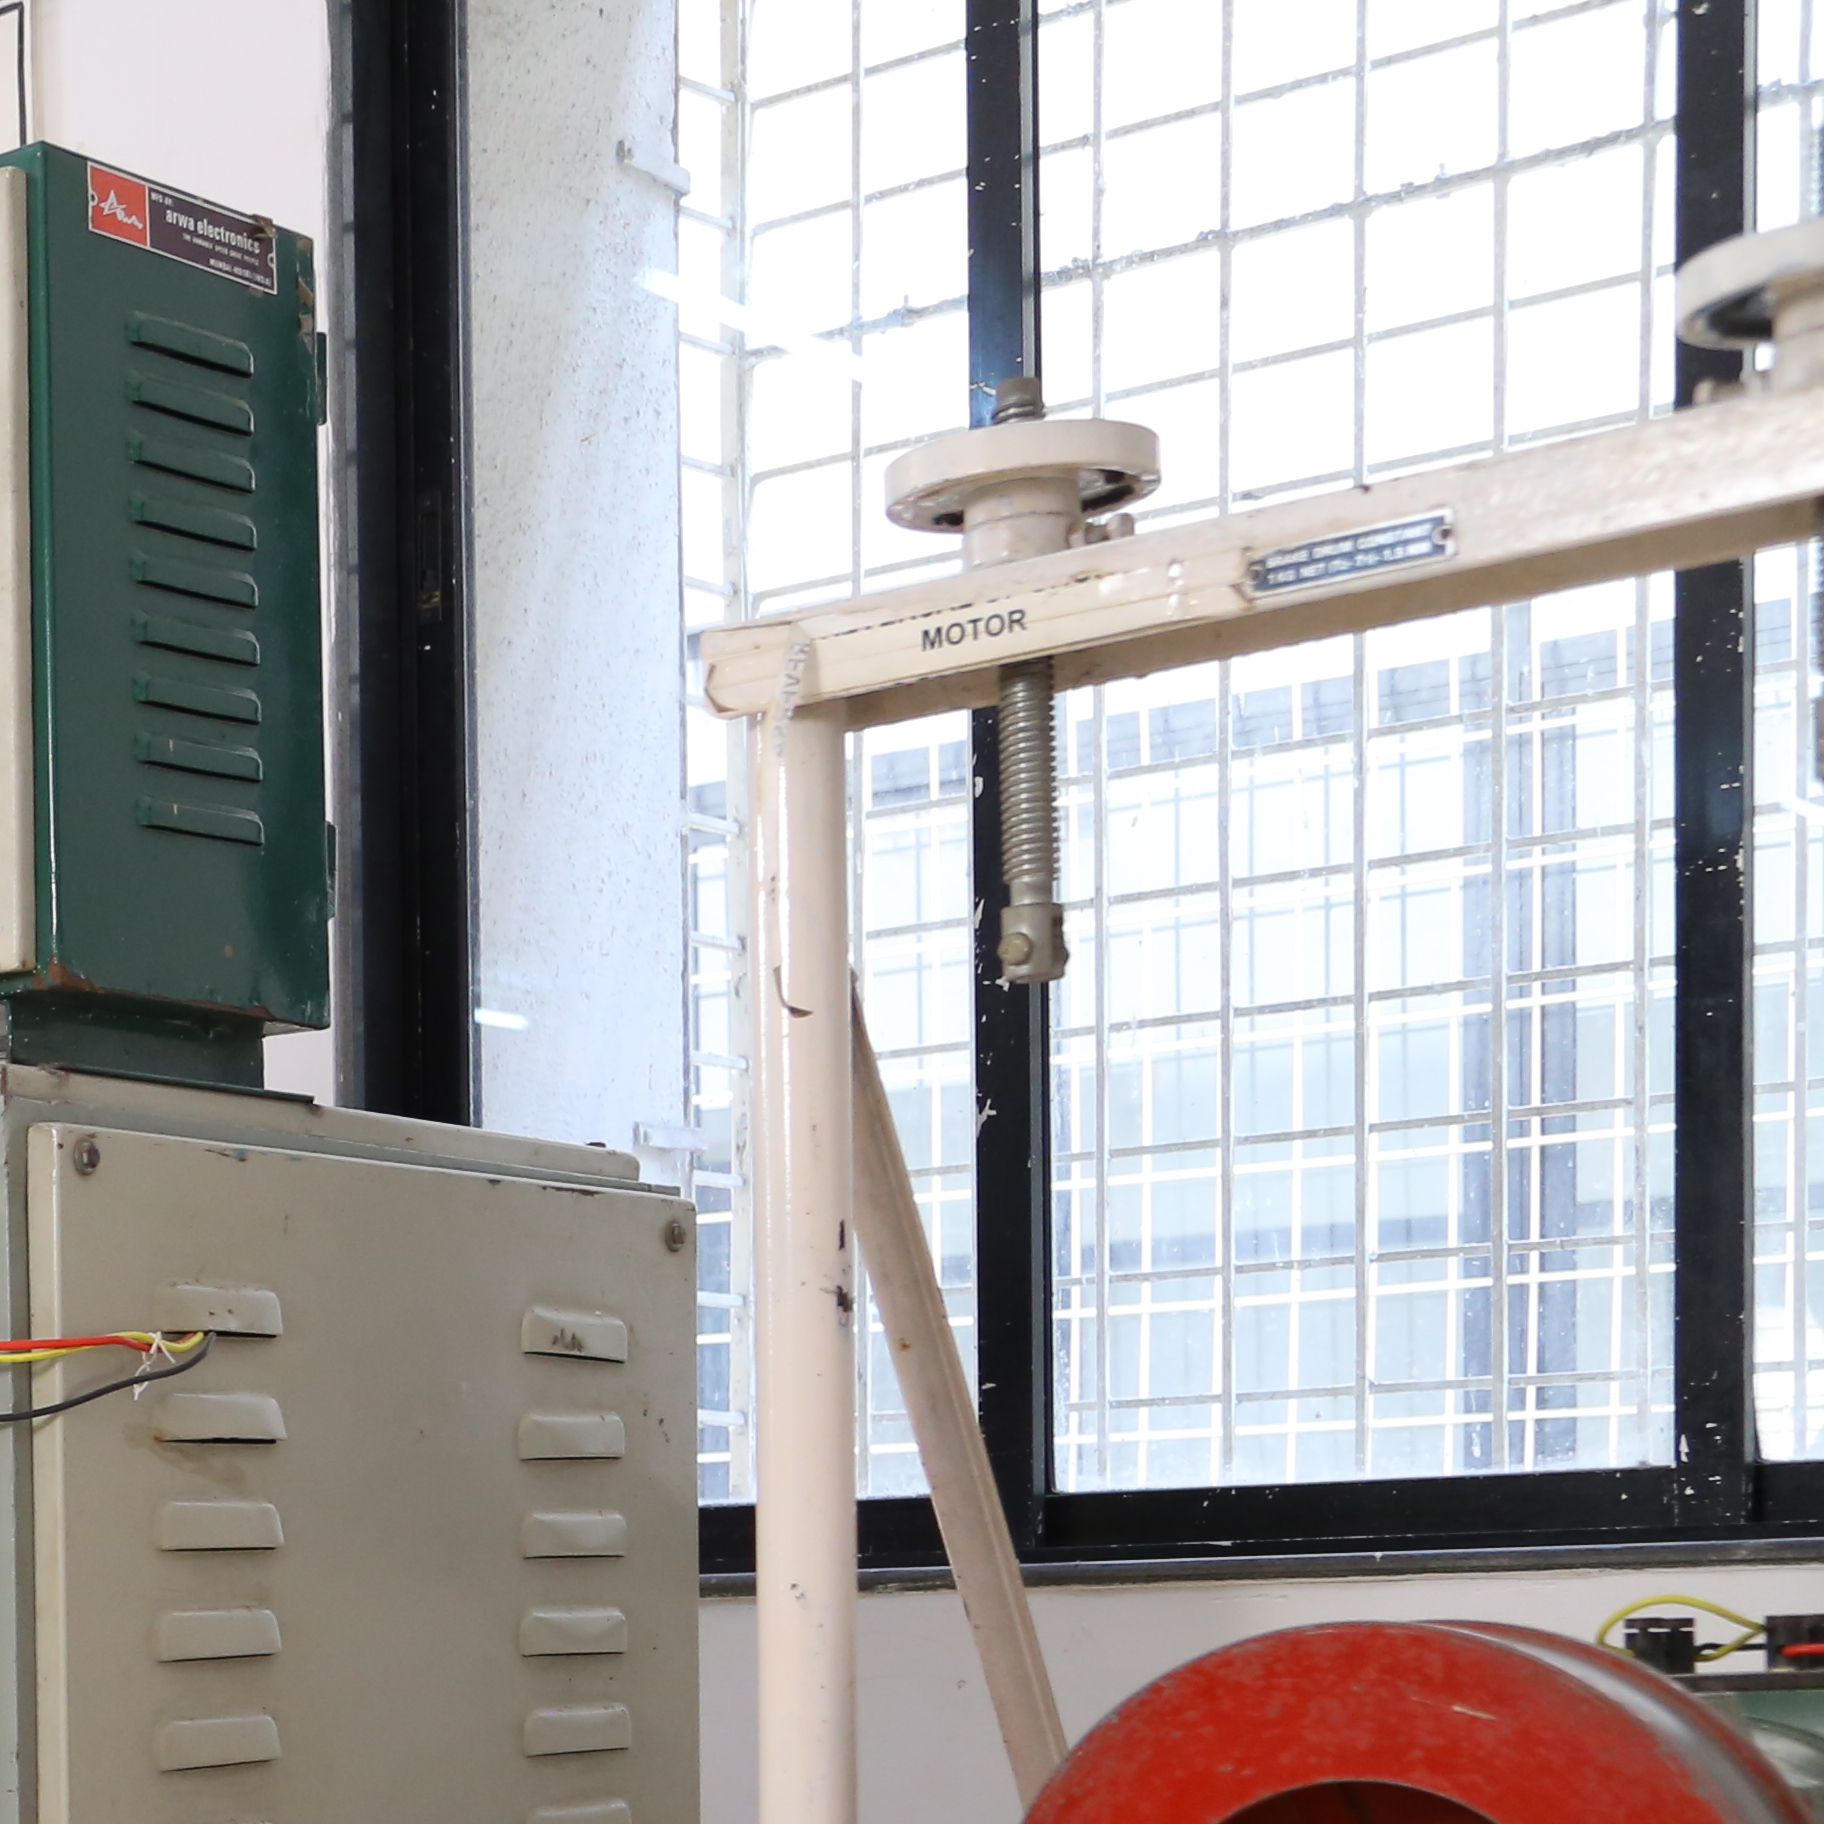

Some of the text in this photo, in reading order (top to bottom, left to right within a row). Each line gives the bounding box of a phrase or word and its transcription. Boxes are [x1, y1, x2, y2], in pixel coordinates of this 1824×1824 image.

[166, 209, 194, 230] arwa
[197, 219, 260, 254] electronics
[921, 609, 1028, 652] MOTOR
